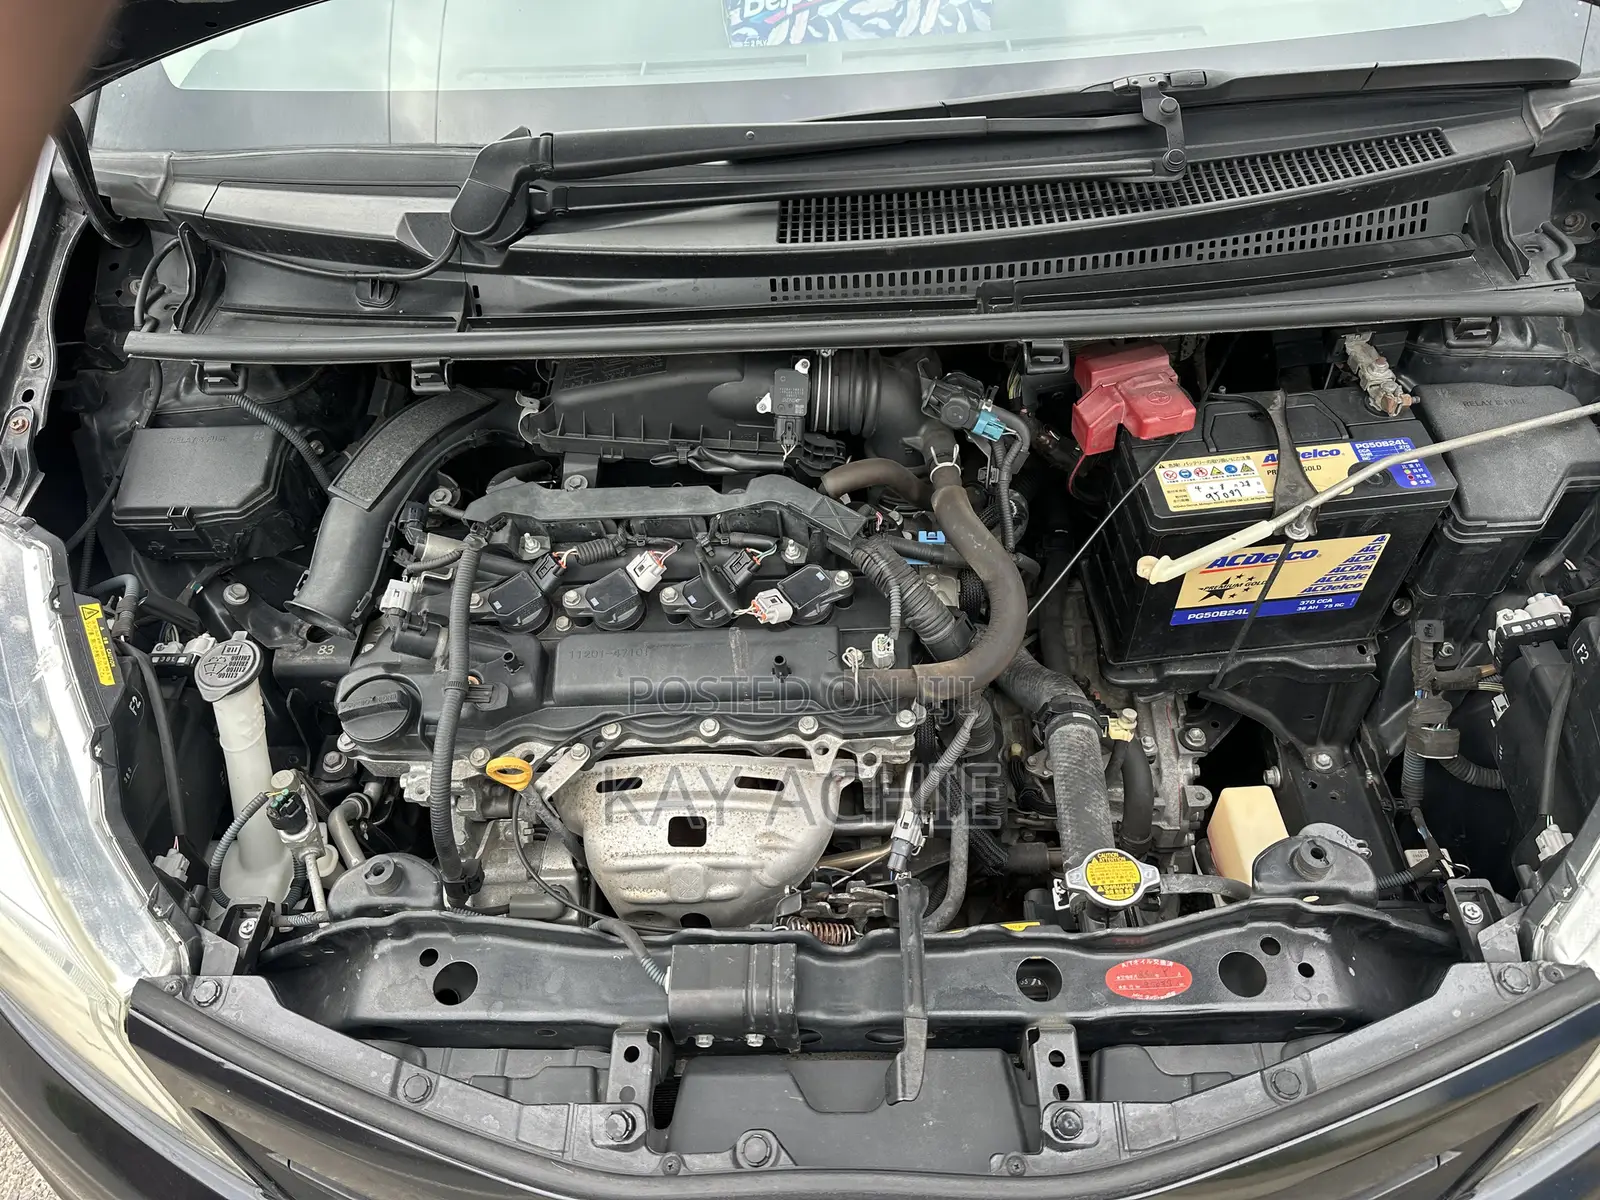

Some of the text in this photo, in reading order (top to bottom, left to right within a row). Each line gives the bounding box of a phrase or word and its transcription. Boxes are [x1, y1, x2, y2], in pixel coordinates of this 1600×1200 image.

[1355, 439, 1408, 449] PG50B24L
[1263, 448, 1341, 463] Aelco
[1205, 549, 1319, 570] ACDeco
[1204, 582, 1243, 591] PREMIUM
[1300, 582, 1363, 594] ACDelco
[1187, 608, 1250, 621] PG50B24L
[317, 645, 335, 654] 83
[1576, 643, 1590, 665] F2
[129, 695, 142, 716] F2
